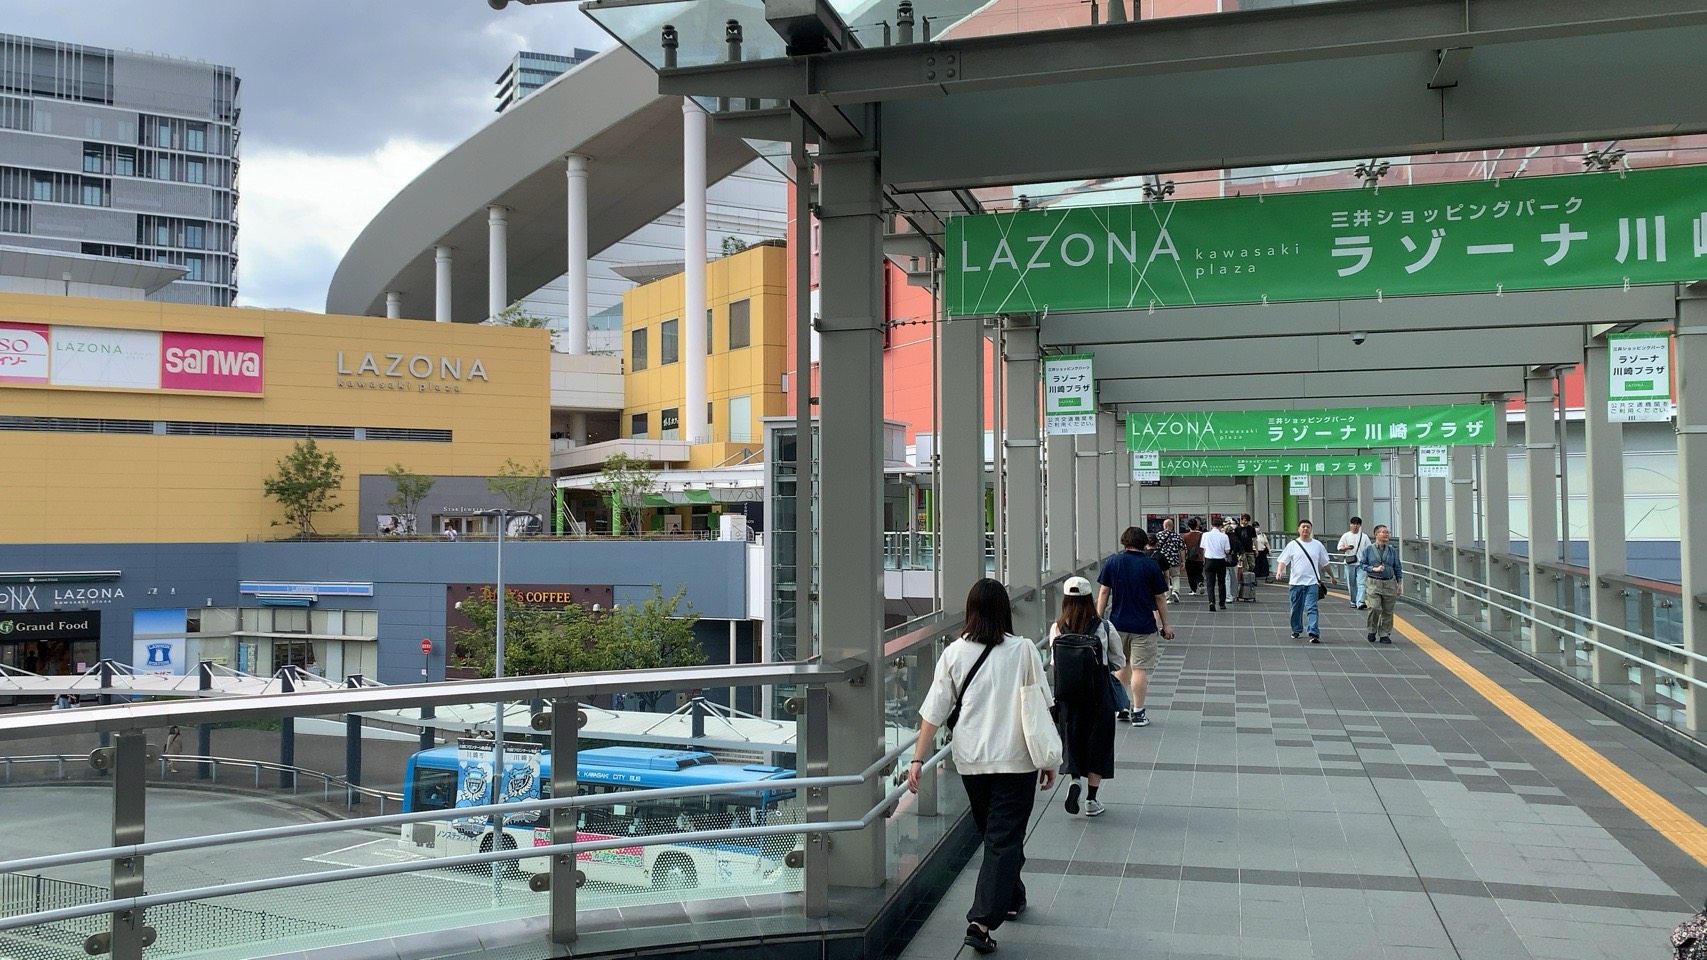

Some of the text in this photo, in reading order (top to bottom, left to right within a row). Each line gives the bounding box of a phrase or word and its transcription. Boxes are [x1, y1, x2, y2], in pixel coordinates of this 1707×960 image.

[1330, 196, 1583, 228] 三井ショッピングパーク
[962, 228, 1180, 272] LAZONA
[1331, 212, 1707, 277] ラゾーナ川
[1195, 243, 1300, 260] kawasaki
[1195, 262, 1256, 280] plaza
[56, 342, 122, 354] LAZONA
[165, 347, 260, 377] sanwa
[1619, 355, 1659, 364] ラゾーナ
[337, 351, 489, 381] LAZONA
[1613, 366, 1665, 376] 川崎プラザ
[1053, 374, 1085, 382] ラゾーナ
[337, 378, 461, 393] kawasaki plaza
[1049, 384, 1090, 393] 川崎プラザ
[1268, 416, 1355, 425] 三井ショッピングパーク
[1132, 421, 1215, 436] LAZONA
[1268, 420, 1484, 442] ラゾーナ川崎プラザ
[1161, 460, 1208, 469] LAZONA
[1237, 462, 1373, 472] ラゾーナ川崎プラザ
[55, 588, 124, 600] LAZONA
[526, 592, 570, 602] COFFEE
[16, 620, 88, 632] Grand Food
